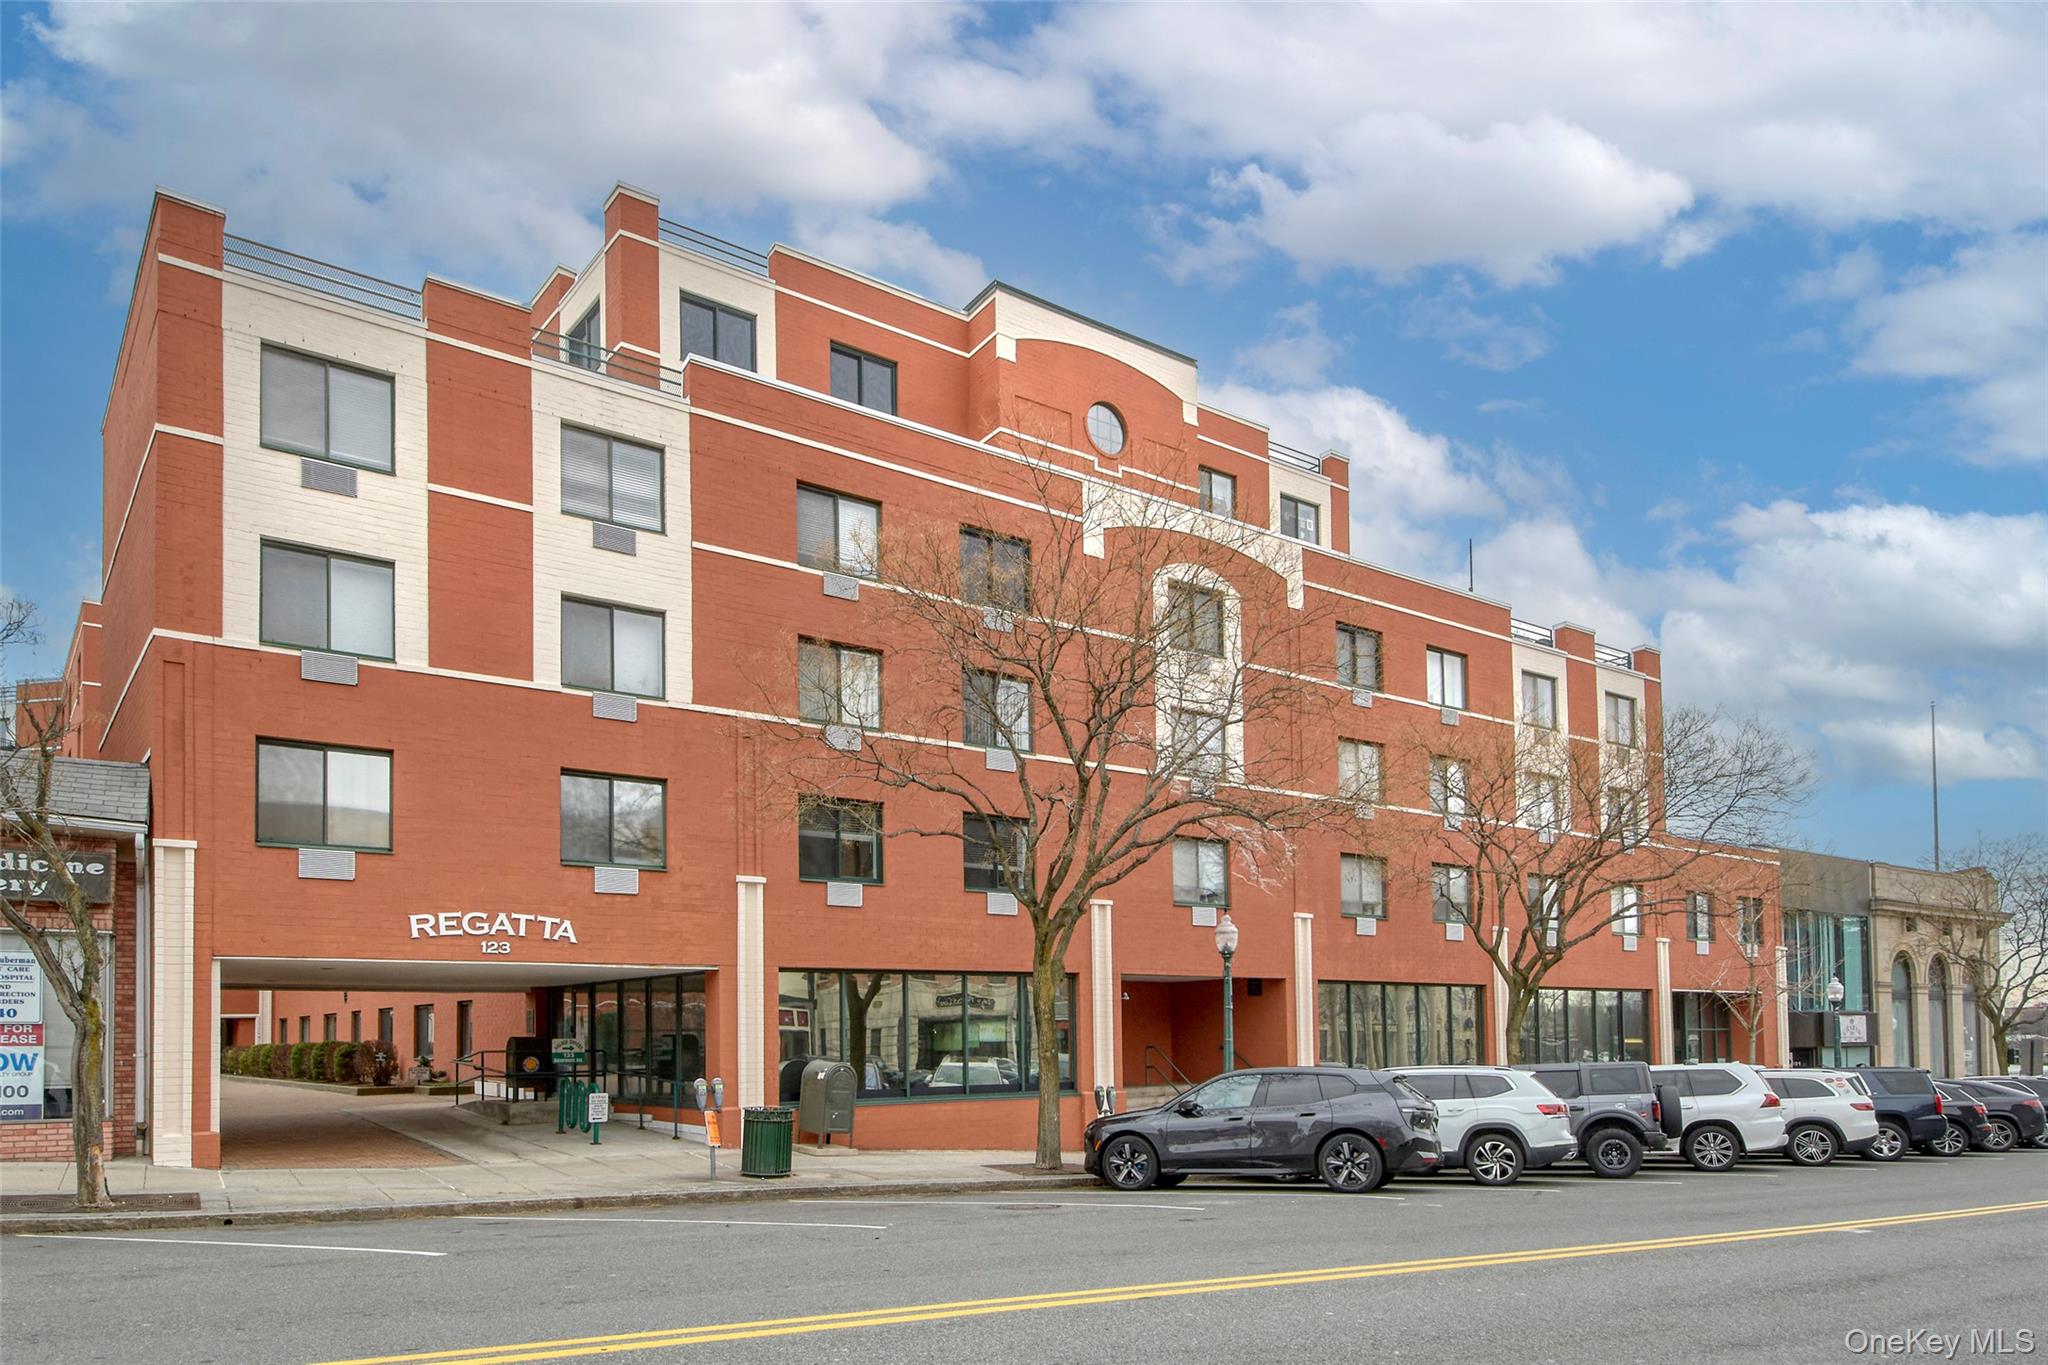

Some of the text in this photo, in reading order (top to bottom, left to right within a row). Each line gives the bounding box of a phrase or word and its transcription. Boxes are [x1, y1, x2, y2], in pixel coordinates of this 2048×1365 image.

[0, 852, 105, 875] dicne
[408, 911, 578, 944] REGATTA
[480, 941, 511, 954] 123
[4, 1024, 33, 1033] FOR
[0, 1034, 37, 1044] EASE
[0, 1085, 29, 1098] 00
